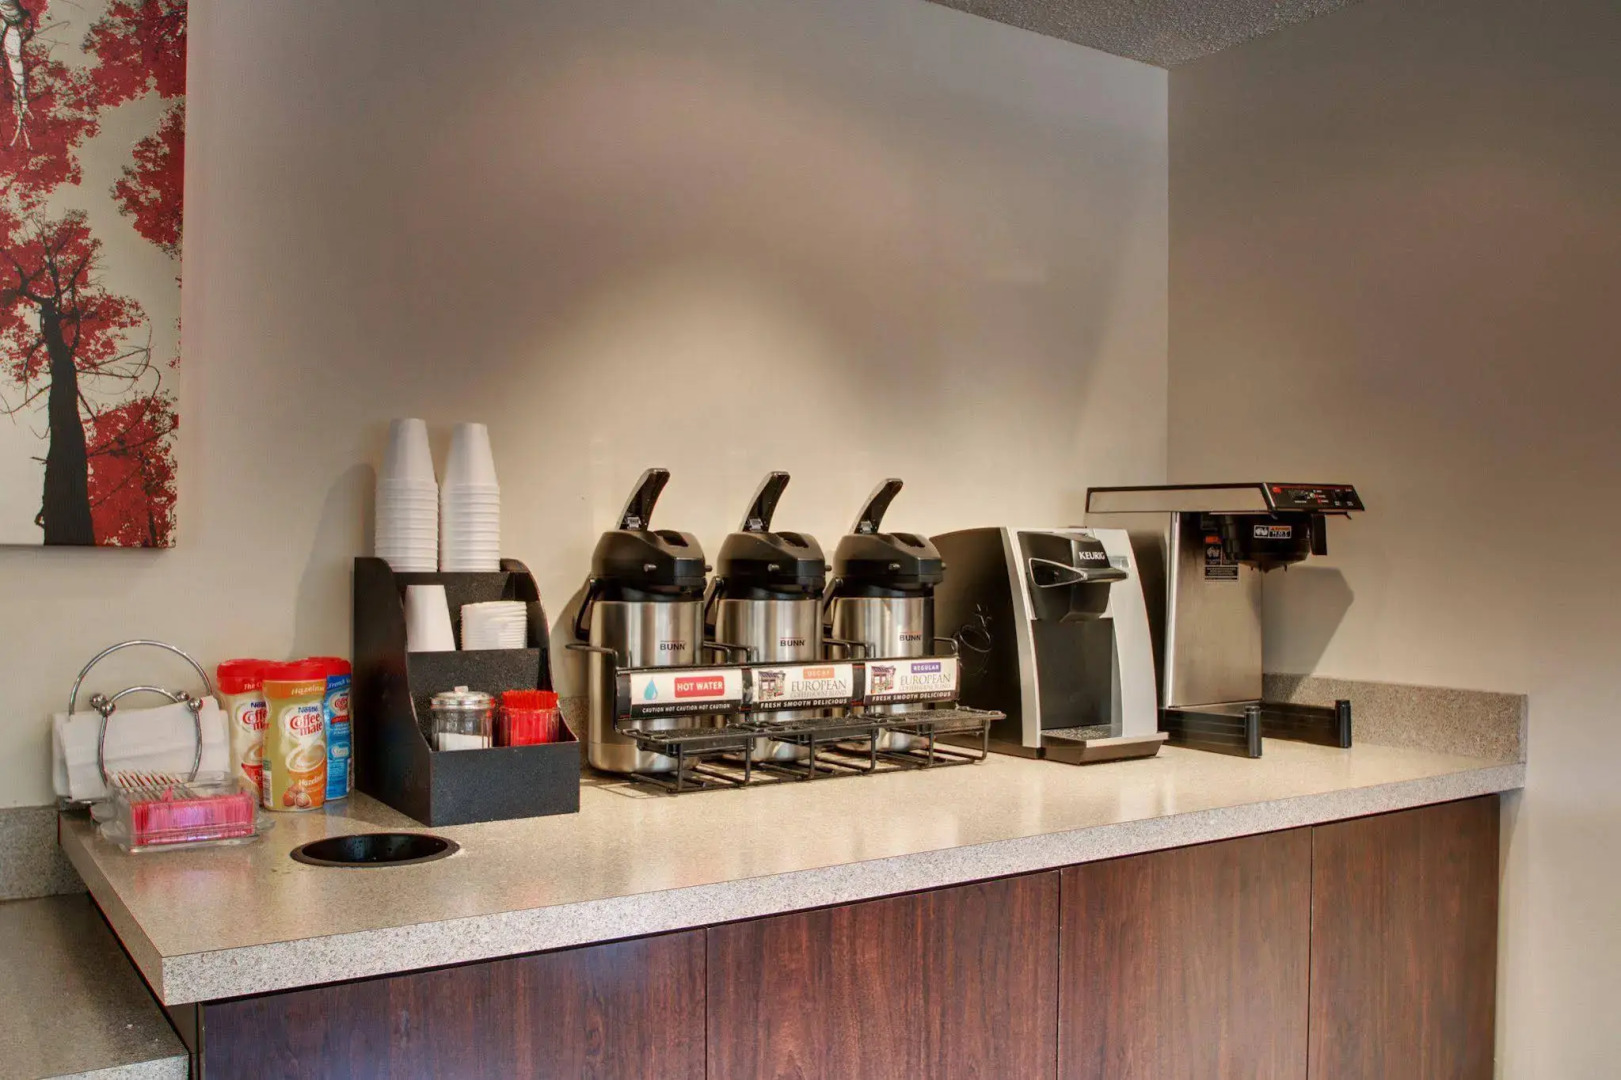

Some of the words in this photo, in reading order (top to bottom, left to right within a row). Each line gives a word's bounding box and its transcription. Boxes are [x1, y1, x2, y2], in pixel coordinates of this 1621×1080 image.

[1079, 551, 1106, 560] KEURIG
[900, 673, 951, 686] EUROPEAN
[244, 683, 256, 691] The
[291, 685, 325, 695] Hazelnu
[677, 683, 694, 692] HOT
[696, 681, 723, 691] WATER
[791, 679, 847, 692] EUROPEAN
[893, 693, 918, 701] SMOOTH
[920, 691, 952, 699] DELICIOUS
[783, 700, 811, 708] SMOOTH
[242, 709, 268, 725] Coffe
[290, 713, 320, 730] Coffee
[300, 721, 323, 736] mate
